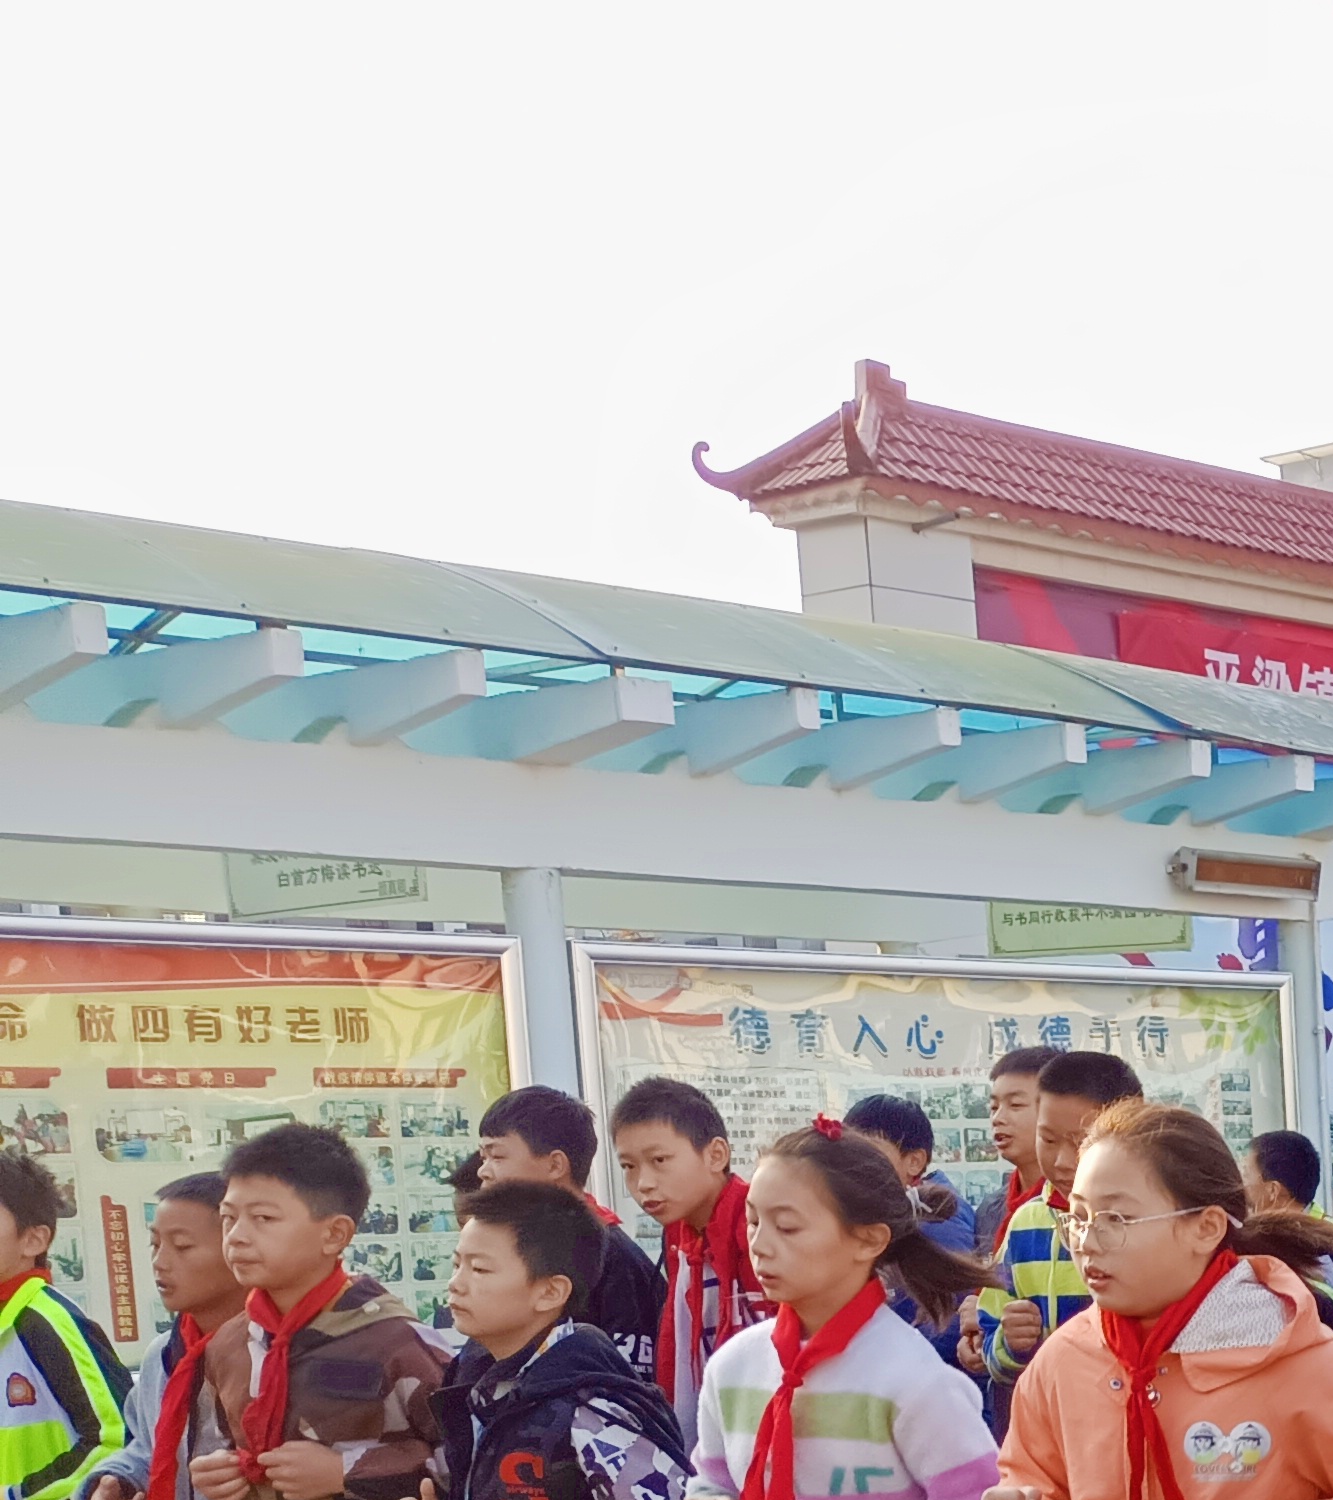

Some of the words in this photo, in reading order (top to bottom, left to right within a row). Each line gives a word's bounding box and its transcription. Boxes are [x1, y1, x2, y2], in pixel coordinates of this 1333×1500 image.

[76, 1003, 370, 1044] 做四有好老师
[728, 1005, 945, 1061] 德育入心
